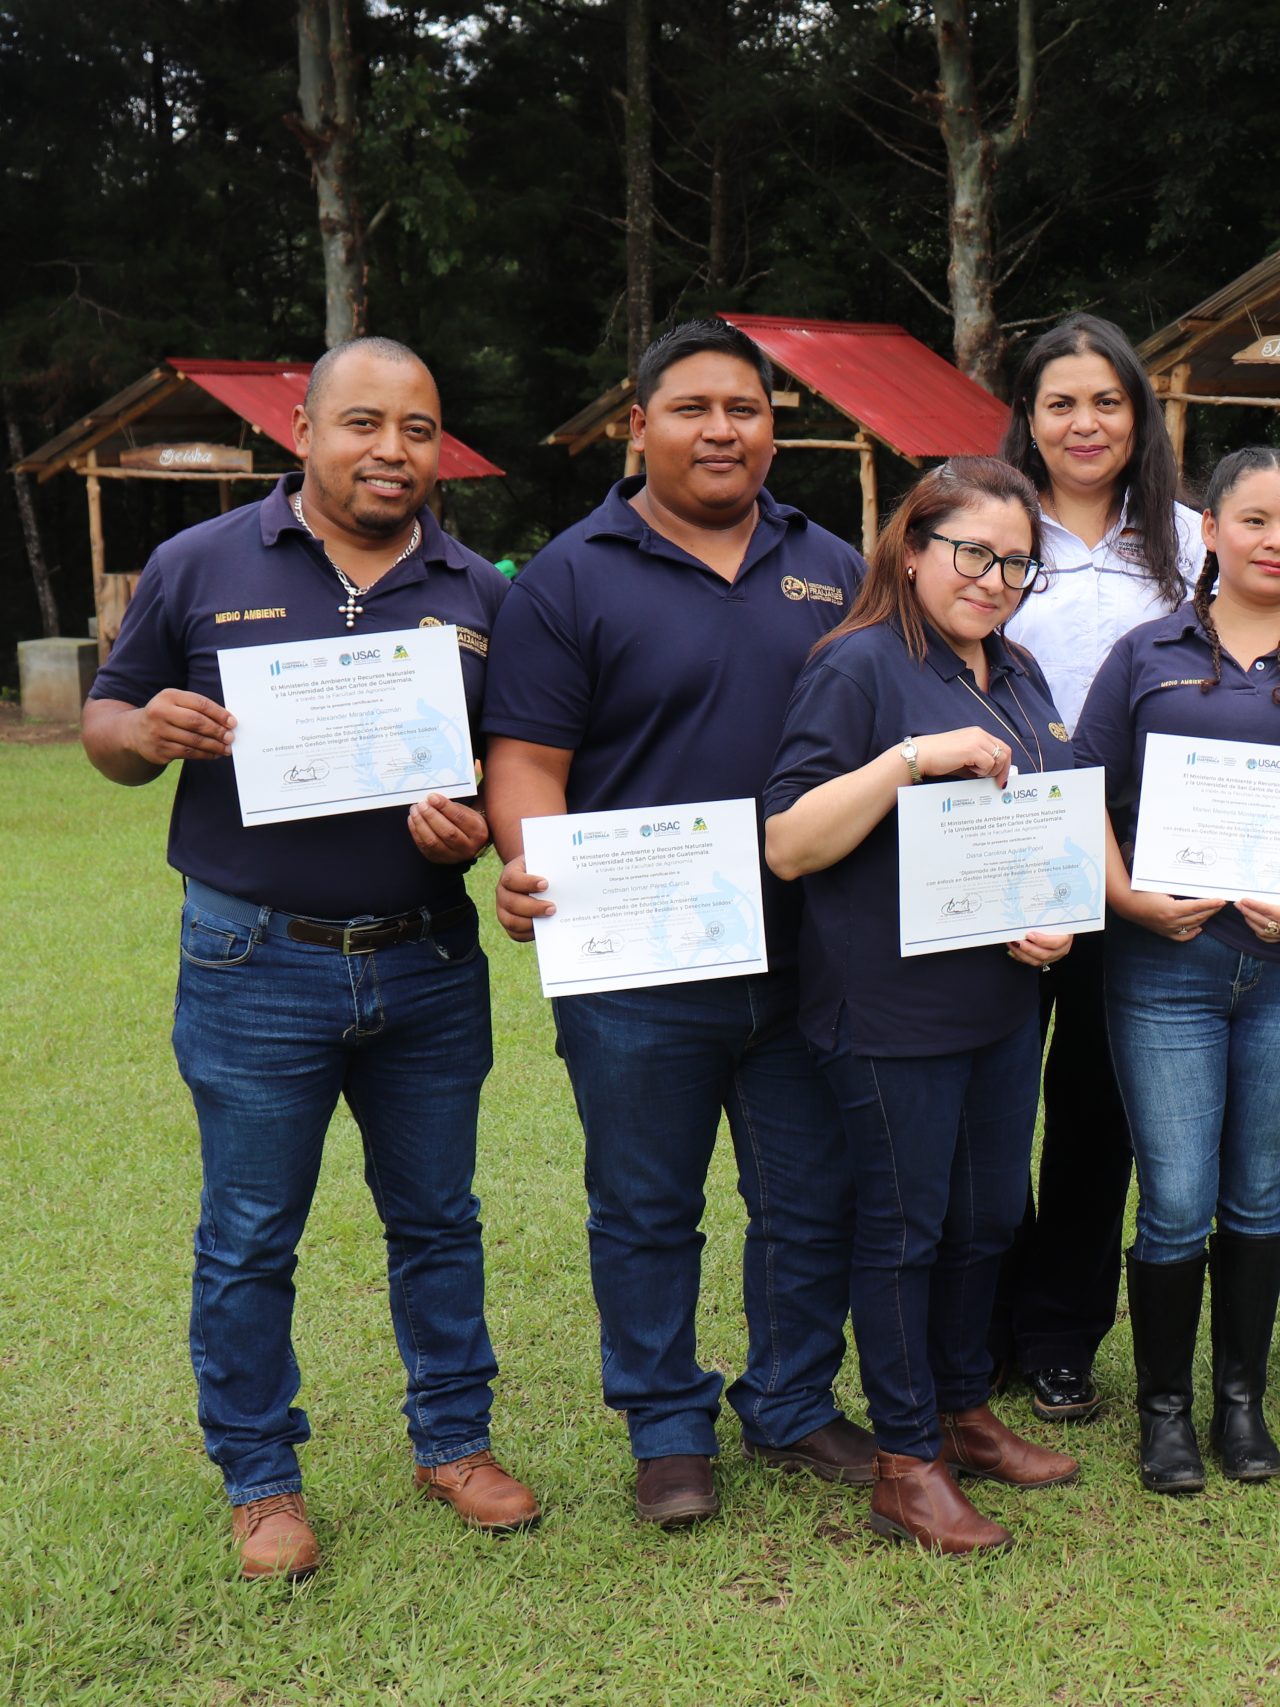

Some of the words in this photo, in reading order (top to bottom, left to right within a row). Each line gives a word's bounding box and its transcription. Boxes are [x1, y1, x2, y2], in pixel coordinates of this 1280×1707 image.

[159, 448, 212, 465] Geisha
[809, 587, 843, 601] FRAIJANES
[215, 610, 240, 624] MEDIO
[243, 607, 286, 620] AMBIENTE
[351, 648, 381, 660] USAC
[278, 681, 309, 690] Ministerio
[320, 676, 351, 685] Ambiente
[357, 672, 384, 680] Recursos
[386, 669, 415, 677] Naturales
[1161, 679, 1177, 688] MEDIO
[287, 686, 324, 696] Universidad
[348, 681, 367, 689] Carlos
[1013, 788, 1038, 799] USAC
[947, 818, 974, 826] Ministerio
[983, 814, 1010, 822] Ambiente
[1040, 808, 1066, 816] Naturales
[652, 820, 680, 832] USAC
[954, 823, 986, 832] Universidad
[579, 852, 609, 860] Ministerio
[620, 848, 650, 856] Ambiente
[656, 844, 683, 852] Recursos
[684, 841, 713, 849] Naturales
[588, 857, 623, 866] Universidad
